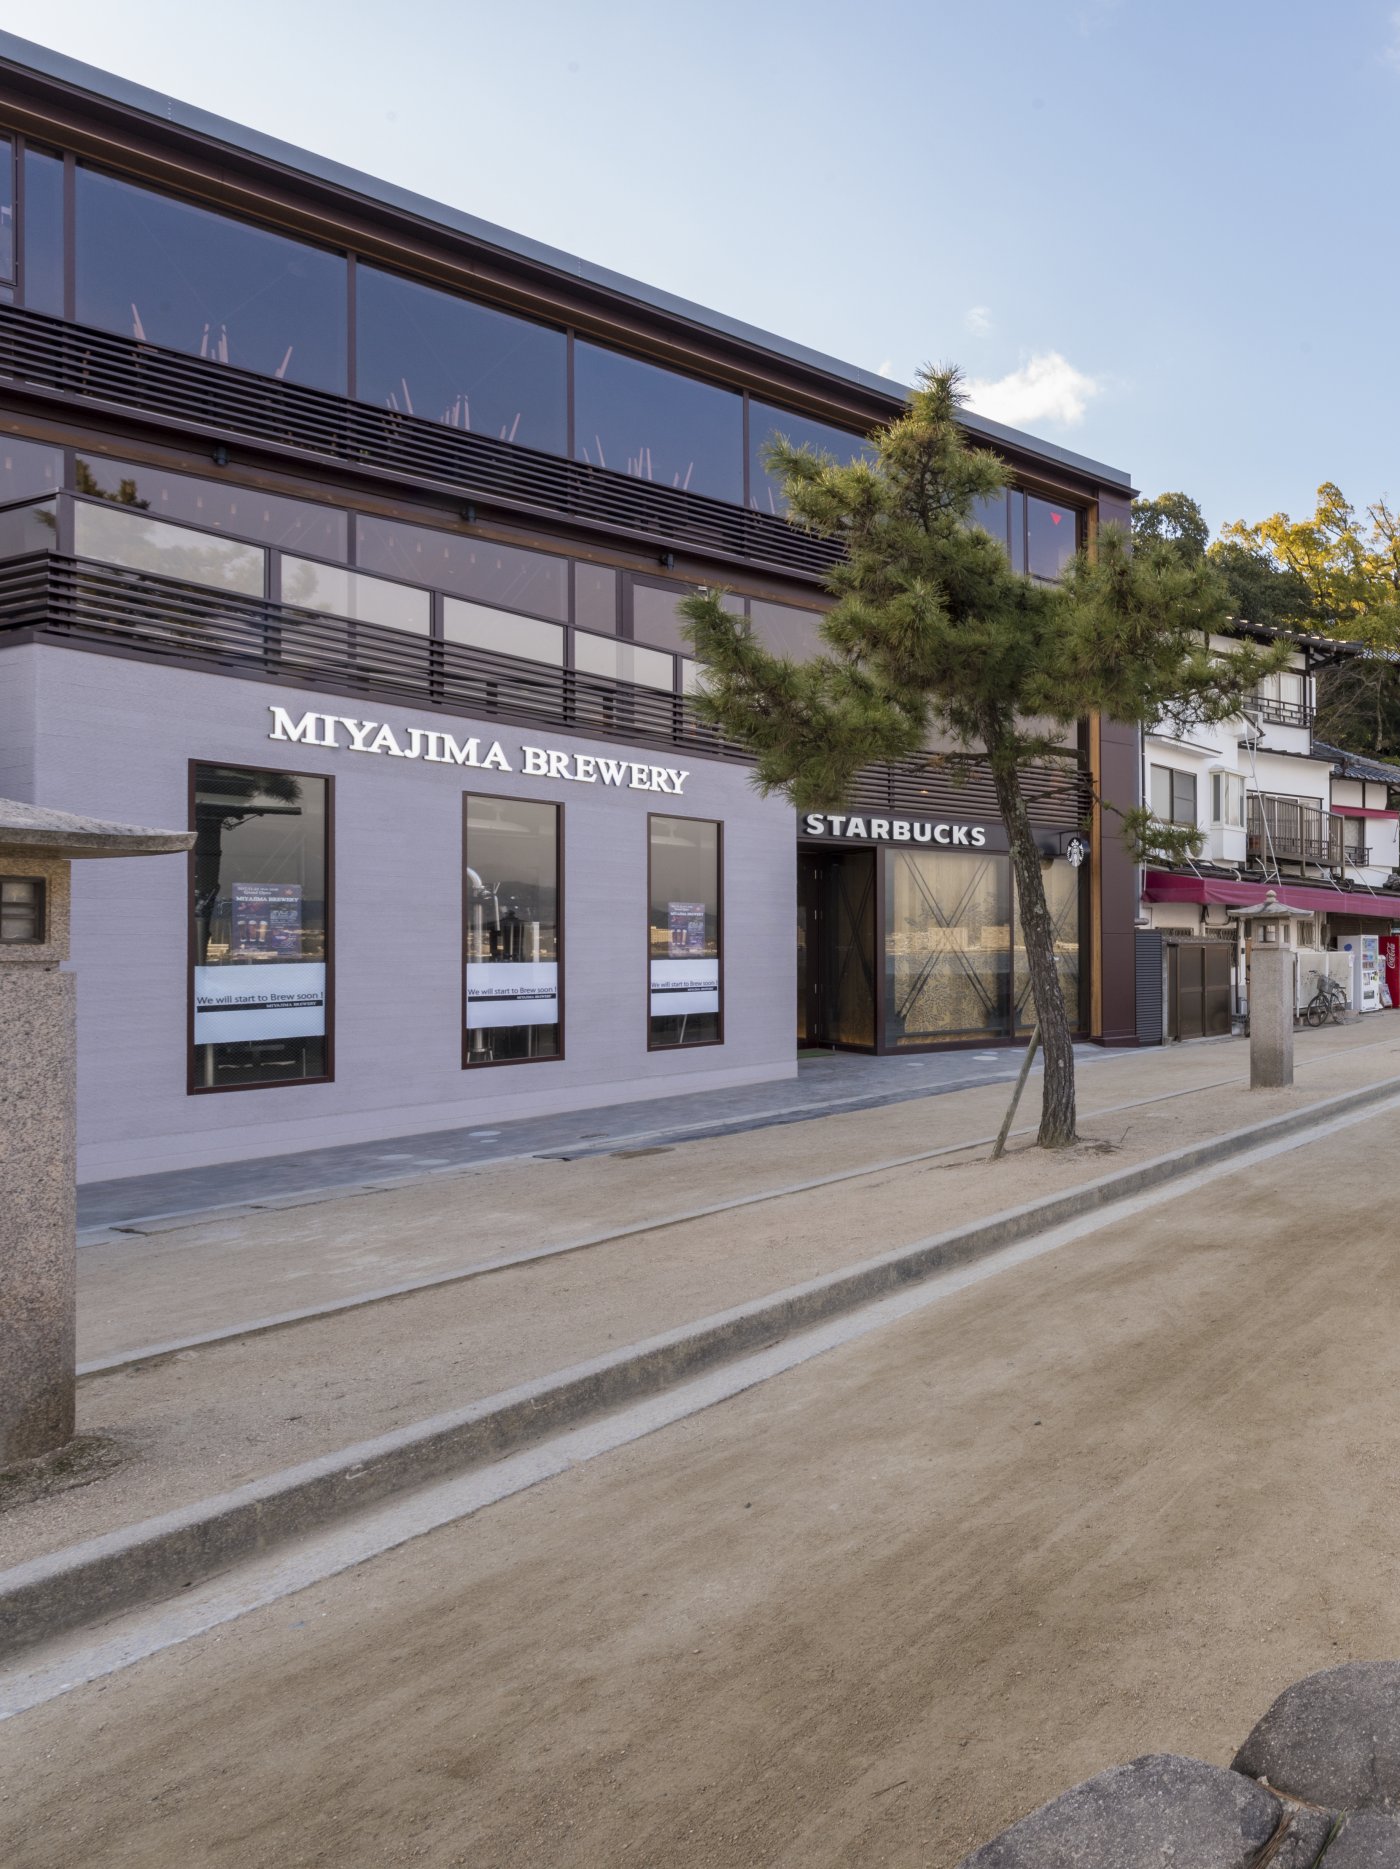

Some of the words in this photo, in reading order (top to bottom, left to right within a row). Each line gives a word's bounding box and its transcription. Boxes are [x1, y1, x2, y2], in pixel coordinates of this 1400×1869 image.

[269, 706, 513, 771] MIYAJIMA
[520, 745, 690, 795] BREWERY
[806, 814, 986, 846] STARBUCKS
[196, 996, 214, 1004] We
[215, 995, 232, 1003] will
[234, 995, 255, 1003] start
[270, 993, 295, 1001] Brew
[296, 992, 318, 1000] soon
[481, 987, 493, 995] will
[494, 987, 510, 995] start
